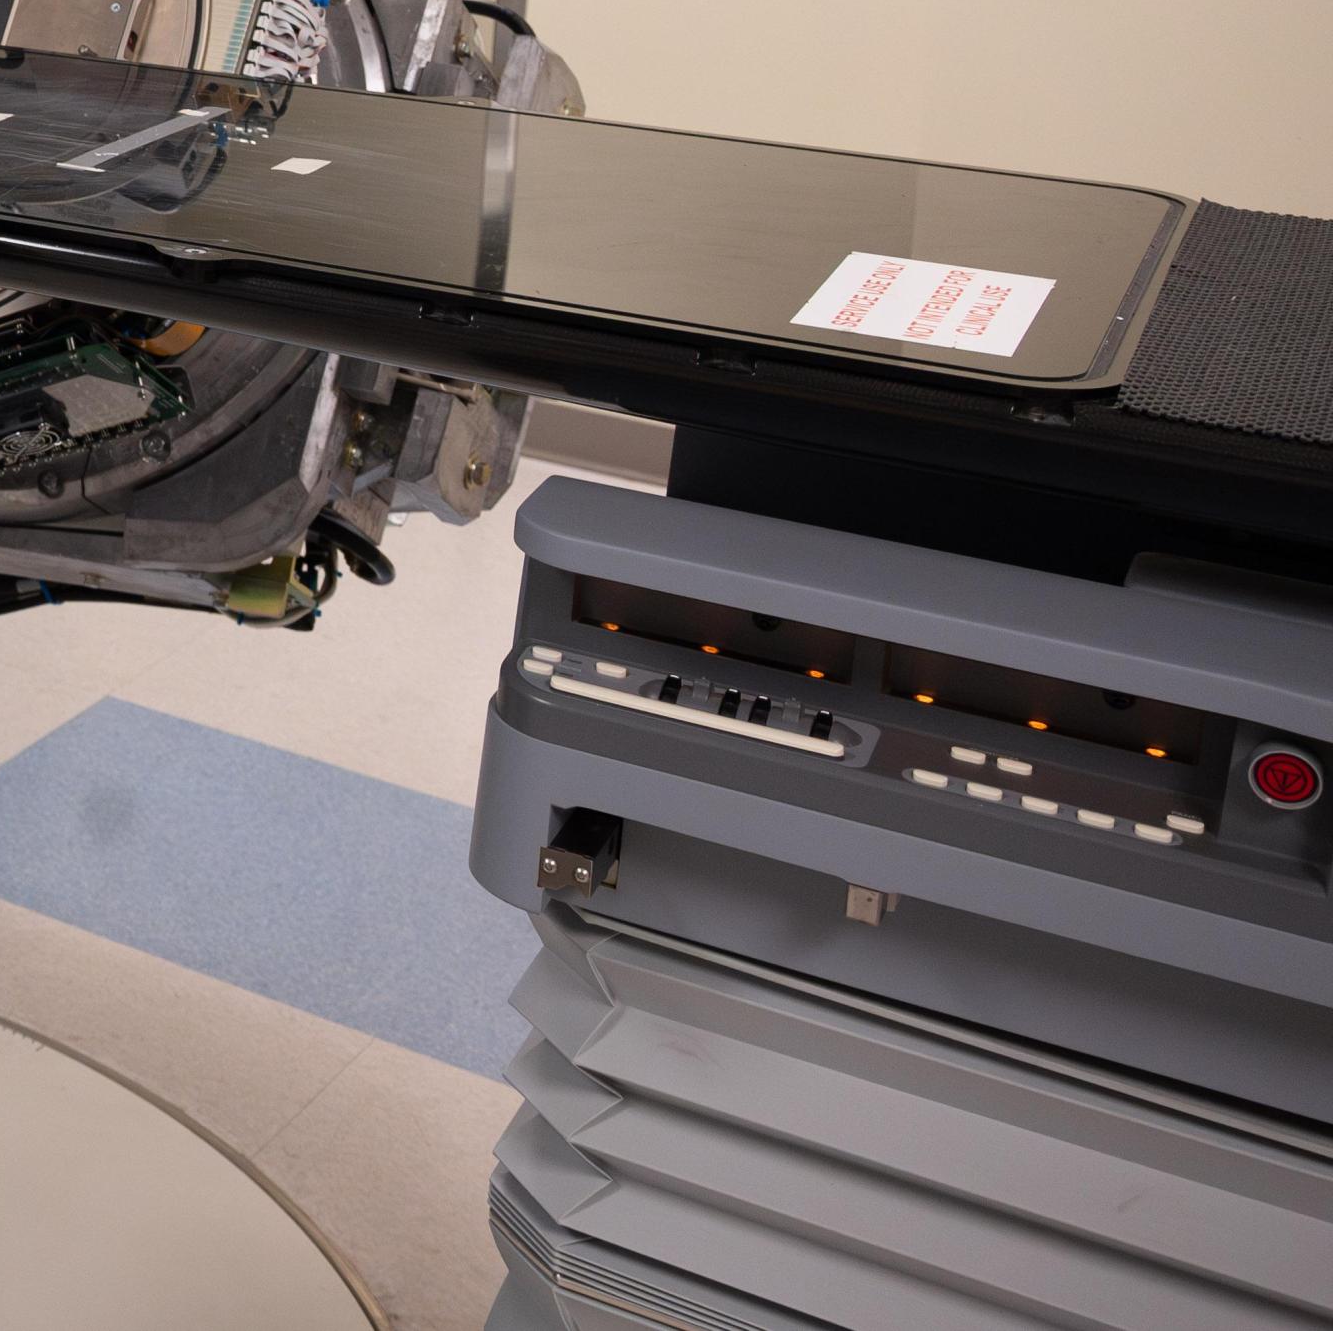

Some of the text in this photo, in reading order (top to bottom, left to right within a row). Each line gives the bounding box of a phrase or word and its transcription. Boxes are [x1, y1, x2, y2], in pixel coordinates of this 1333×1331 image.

[832, 261, 908, 328] SERVICE USE ONLY
[903, 270, 977, 340] NOT INTENDED FOR
[955, 284, 1012, 336] CLINICAL USE
